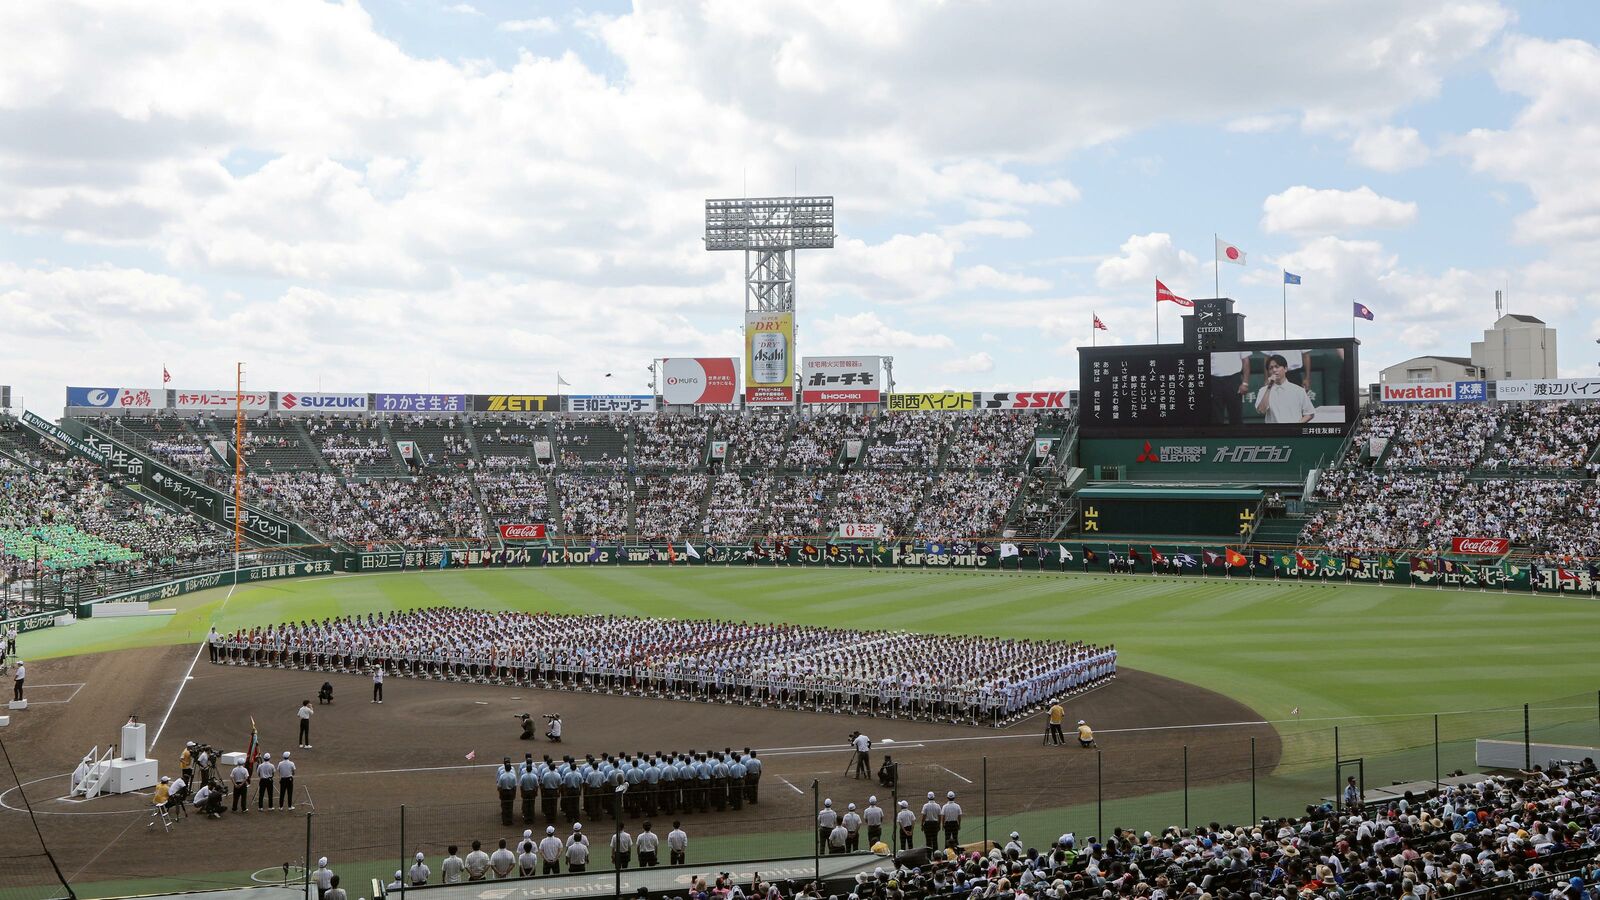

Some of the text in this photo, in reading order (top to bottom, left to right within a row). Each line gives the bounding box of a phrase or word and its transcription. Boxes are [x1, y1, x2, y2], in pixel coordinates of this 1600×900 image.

[754, 348, 784, 361] Asahi
[1103, 362, 1110, 376] ああ
[808, 372, 873, 386] ホーチキ
[1384, 384, 1452, 399] Iwatani
[1459, 383, 1482, 394] 水素
[120, 390, 151, 407] 白鶴
[178, 394, 267, 405] ホテルニューアワジ
[301, 396, 364, 408] SUZUKI
[384, 394, 458, 410] わかさ生活
[487, 396, 548, 410] ZETT
[574, 400, 649, 411] 三和シャッター
[890, 394, 972, 409] 関西ペイント
[1012, 392, 1066, 408] SSK
[31, 417, 51, 431] ENJOY
[84, 435, 143, 475] 大同生命
[164, 477, 213, 507] 住友ファーマ
[225, 506, 287, 539] 日興アセット
[362, 554, 442, 568] 田辺三菱製薬
[564, 550, 608, 564] hoe
[628, 552, 687, 561] MANCA
[893, 550, 987, 566] Panasonic
[314, 562, 331, 572] 住友
[716, 868, 816, 880] demitsu
